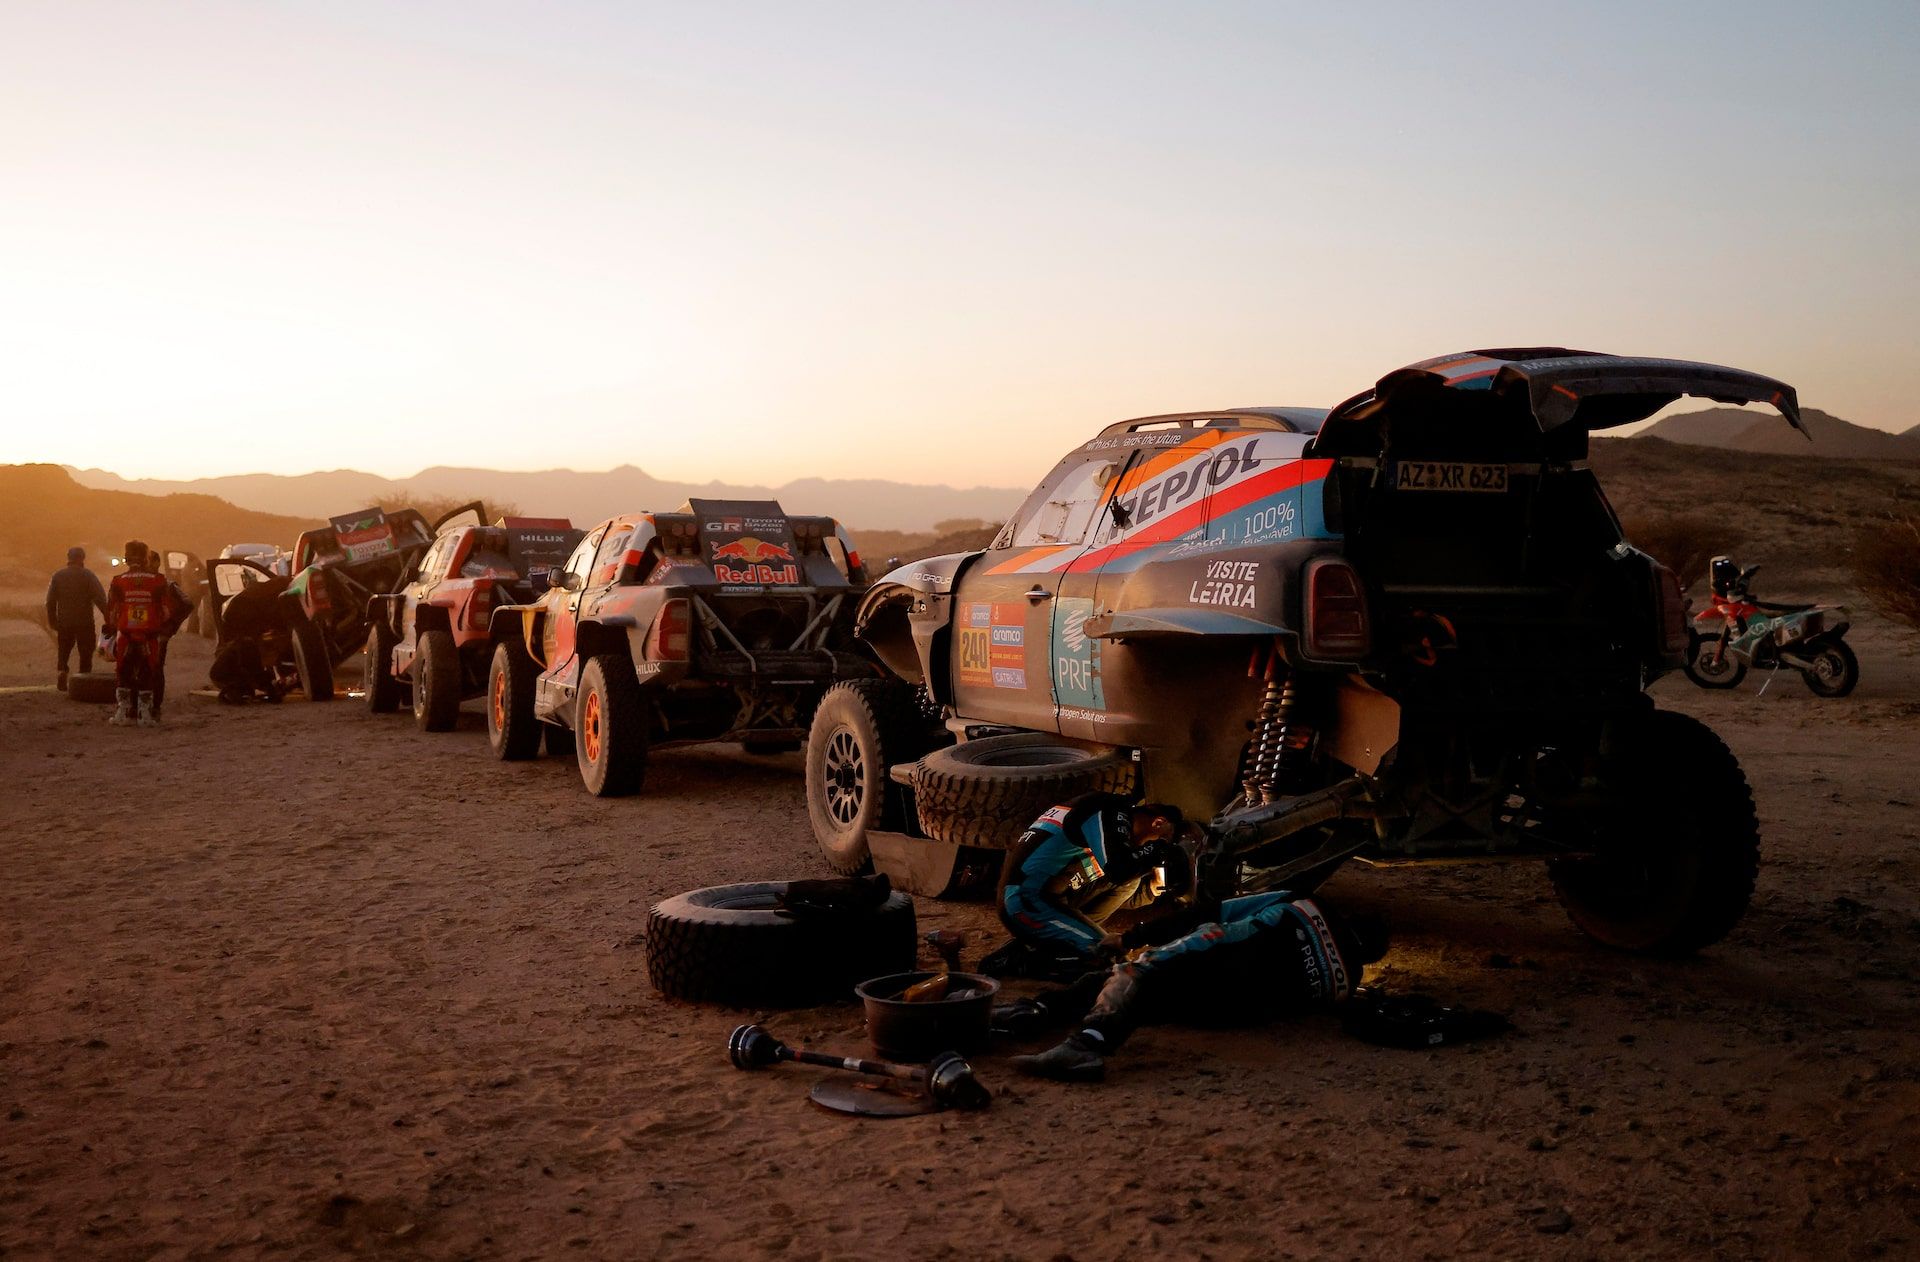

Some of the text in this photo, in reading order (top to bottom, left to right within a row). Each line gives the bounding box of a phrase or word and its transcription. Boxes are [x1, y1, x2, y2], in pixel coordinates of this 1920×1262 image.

[1399, 463, 1505, 489] AZ XR 623
[706, 522, 741, 532] GR
[1244, 501, 1294, 538] 100%
[520, 534, 564, 543] HILUX
[714, 563, 799, 584] Red Bull
[1206, 560, 1259, 581] VISITE
[1189, 580, 1256, 609] LEIRIA
[993, 629, 1020, 642] aramco
[962, 631, 987, 669] 240
[636, 662, 661, 675] HILUX
[1059, 658, 1091, 691] PRF
[1311, 915, 1347, 992] REPSOL
